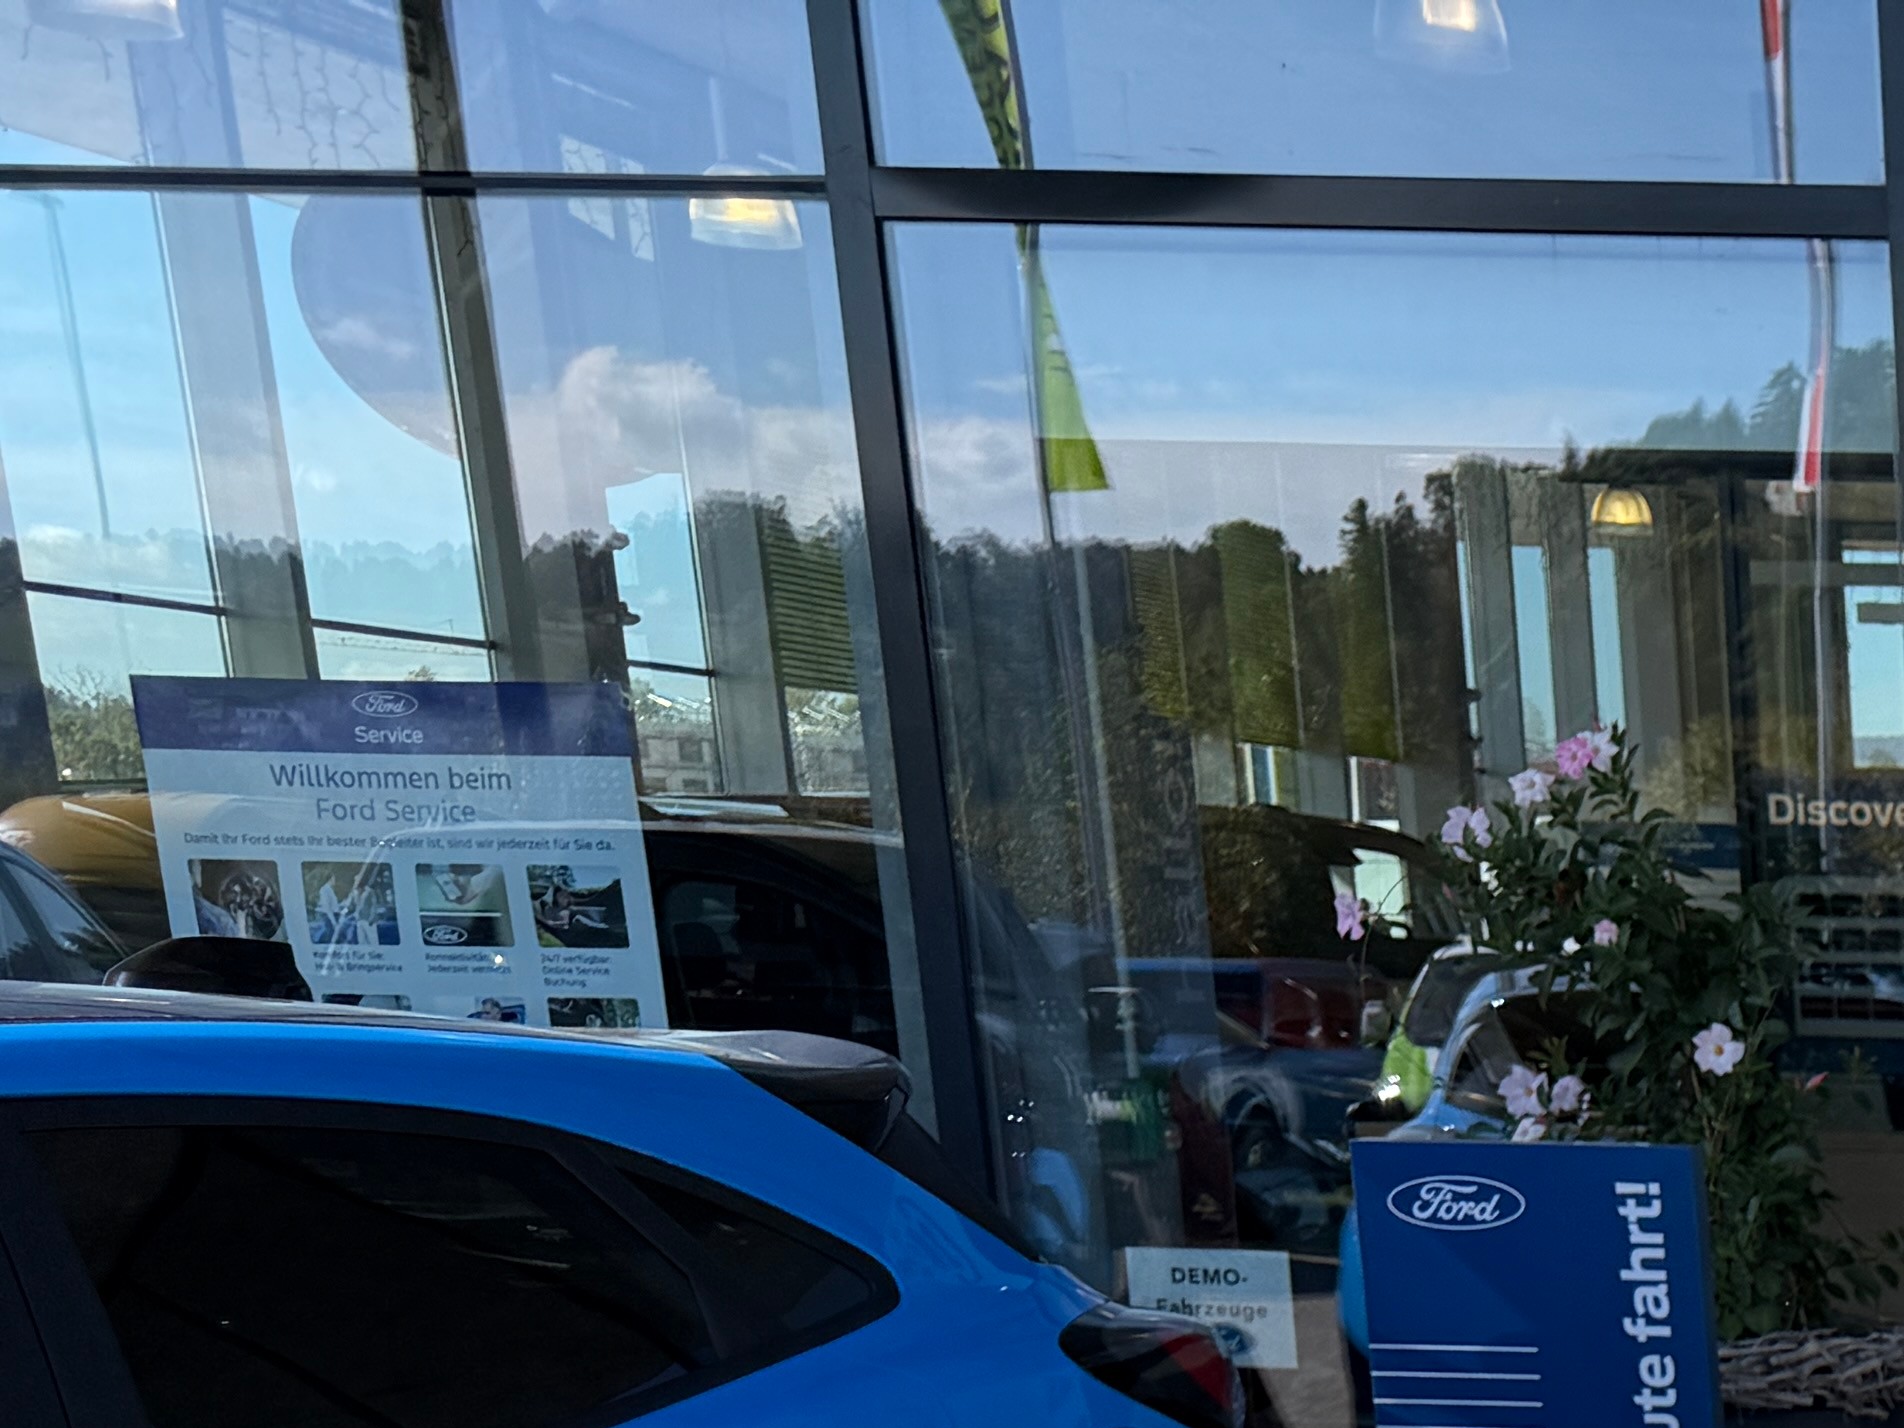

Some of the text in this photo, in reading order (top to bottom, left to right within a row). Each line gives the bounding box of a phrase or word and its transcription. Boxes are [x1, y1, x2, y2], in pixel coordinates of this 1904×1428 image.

[355, 726, 424, 744] Service
[270, 763, 512, 791] Willkommen beim
[317, 798, 476, 822] Ford Service
[184, 832, 219, 845] Damit
[242, 833, 270, 846] Ford
[1614, 1181, 1673, 1343] fahrt!
[1171, 1266, 1248, 1287] DEMO-
[1156, 1296, 1268, 1323] Fahrzeuge
